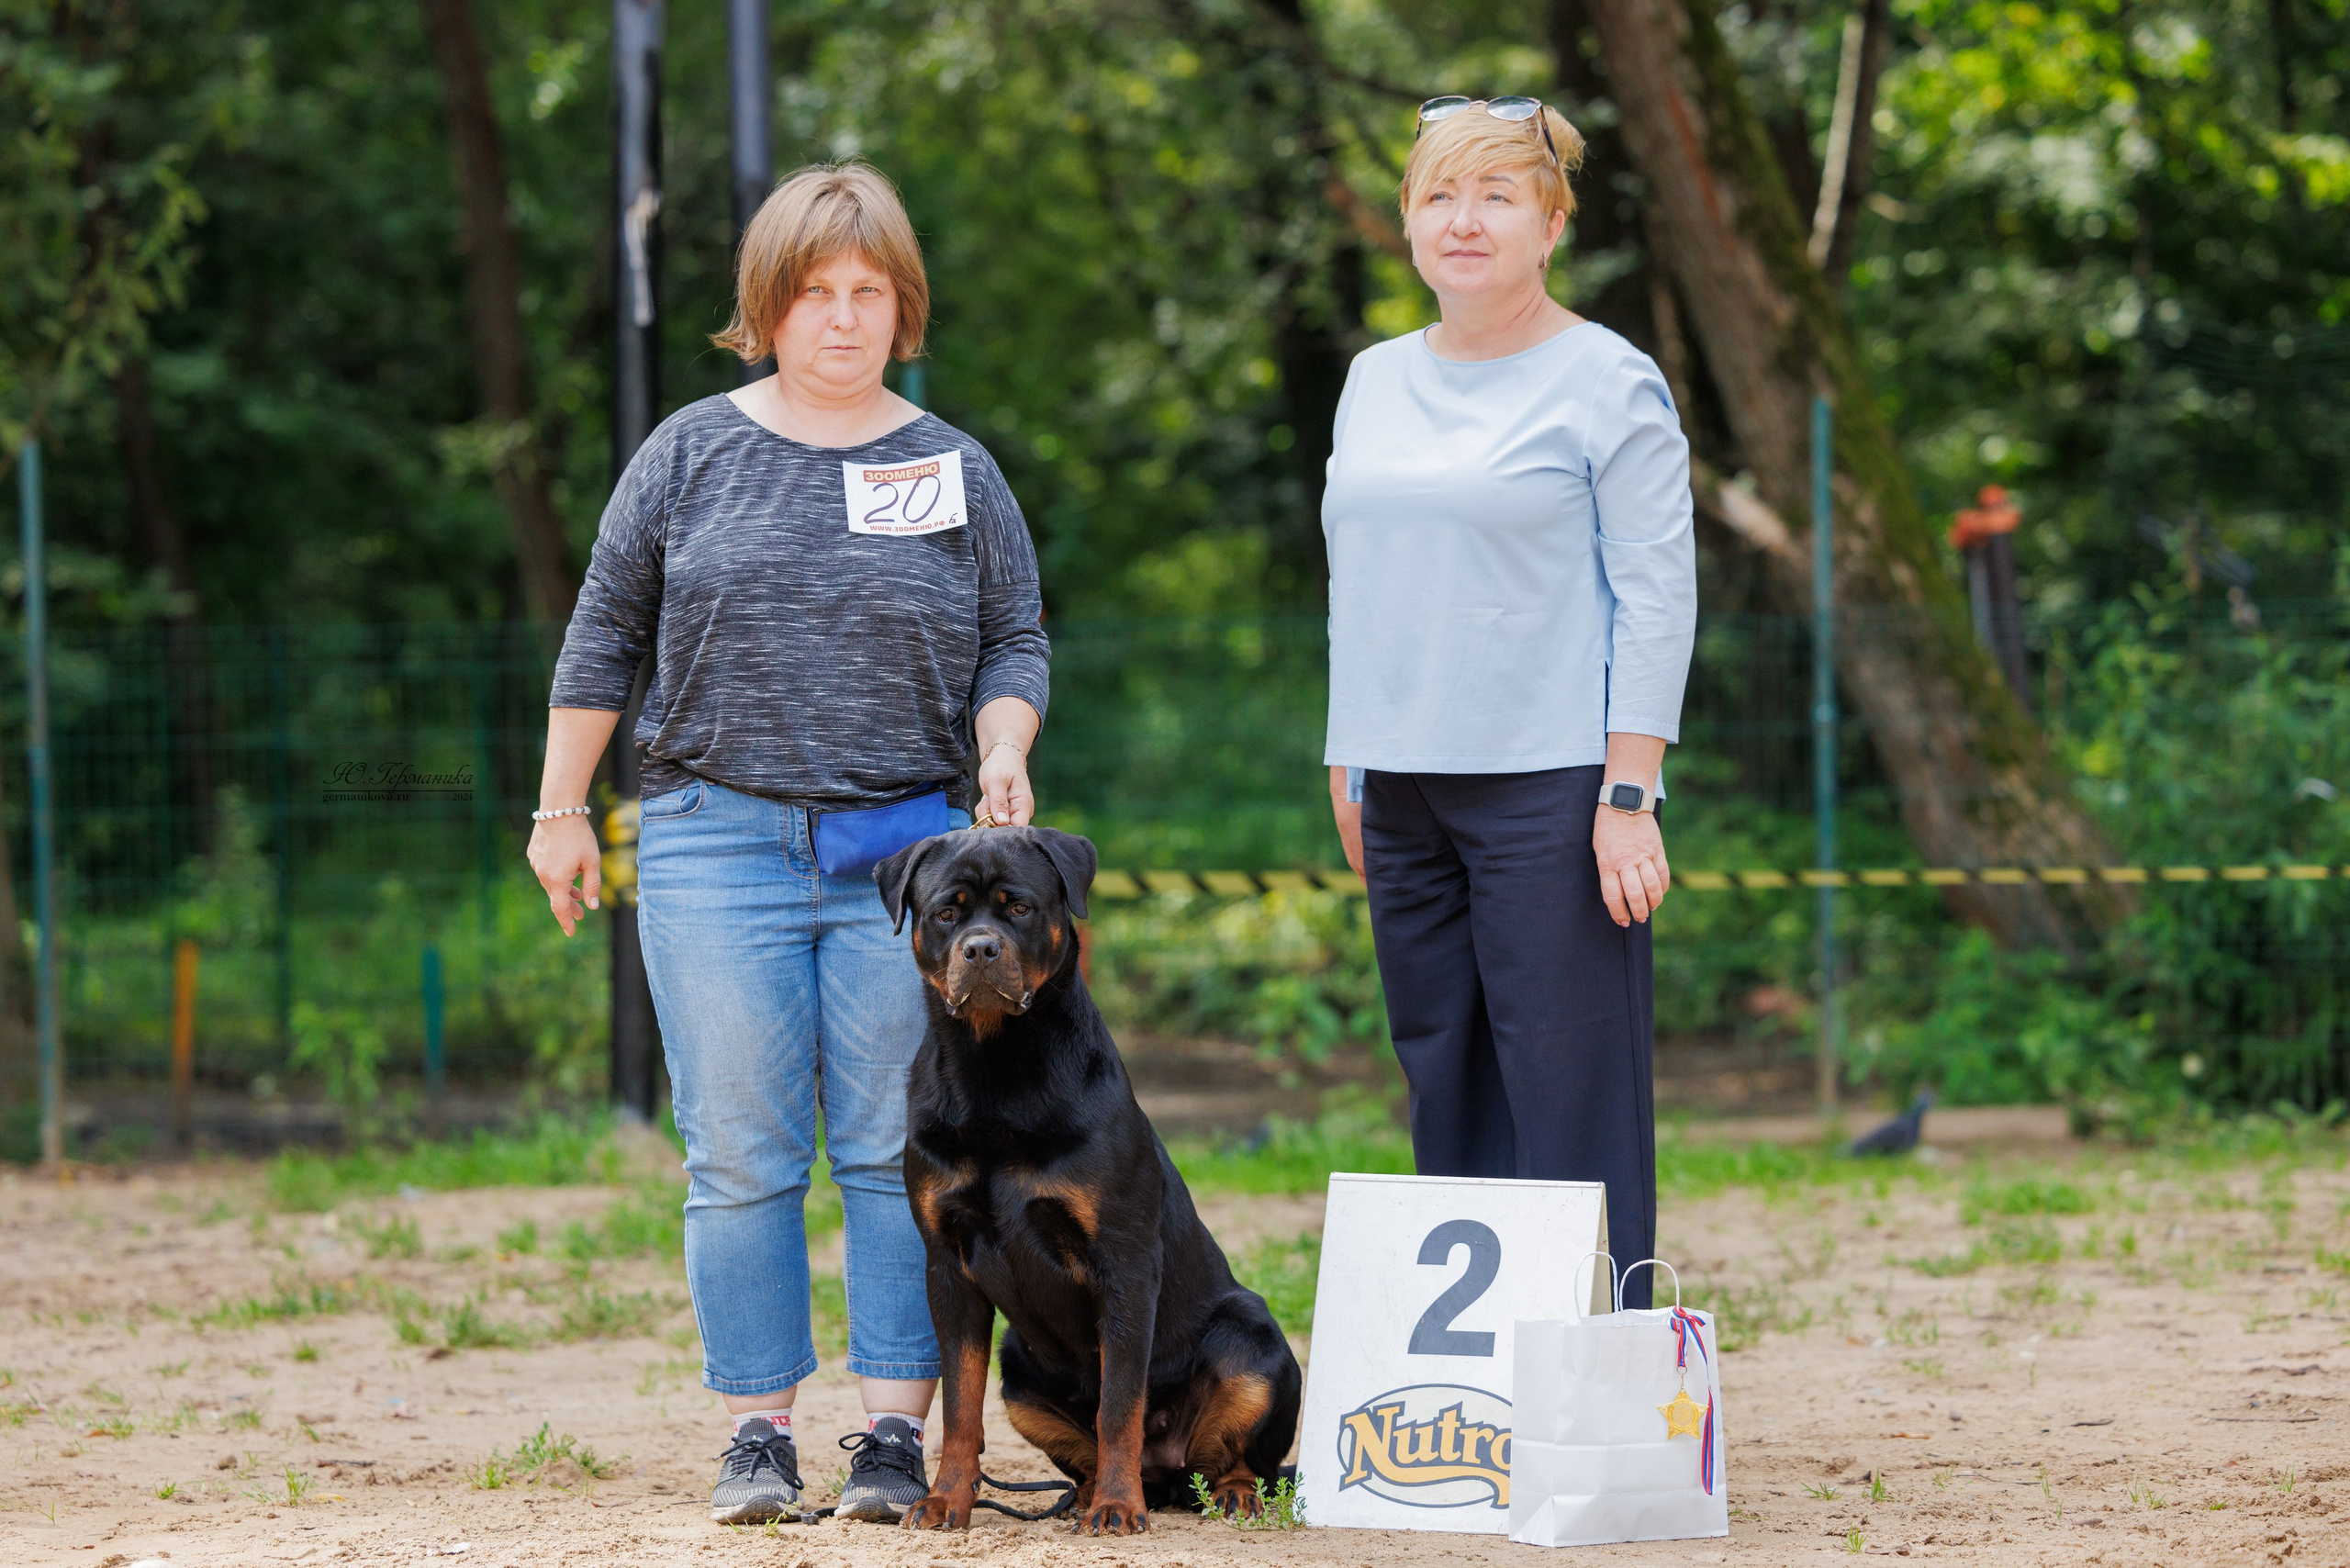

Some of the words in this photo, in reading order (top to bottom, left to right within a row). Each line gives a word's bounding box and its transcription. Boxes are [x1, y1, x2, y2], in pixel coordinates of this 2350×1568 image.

[865, 464, 939, 482] ЗООМЕНЮ
[864, 475, 941, 524] 20
[1407, 1219, 1502, 1357] 2
